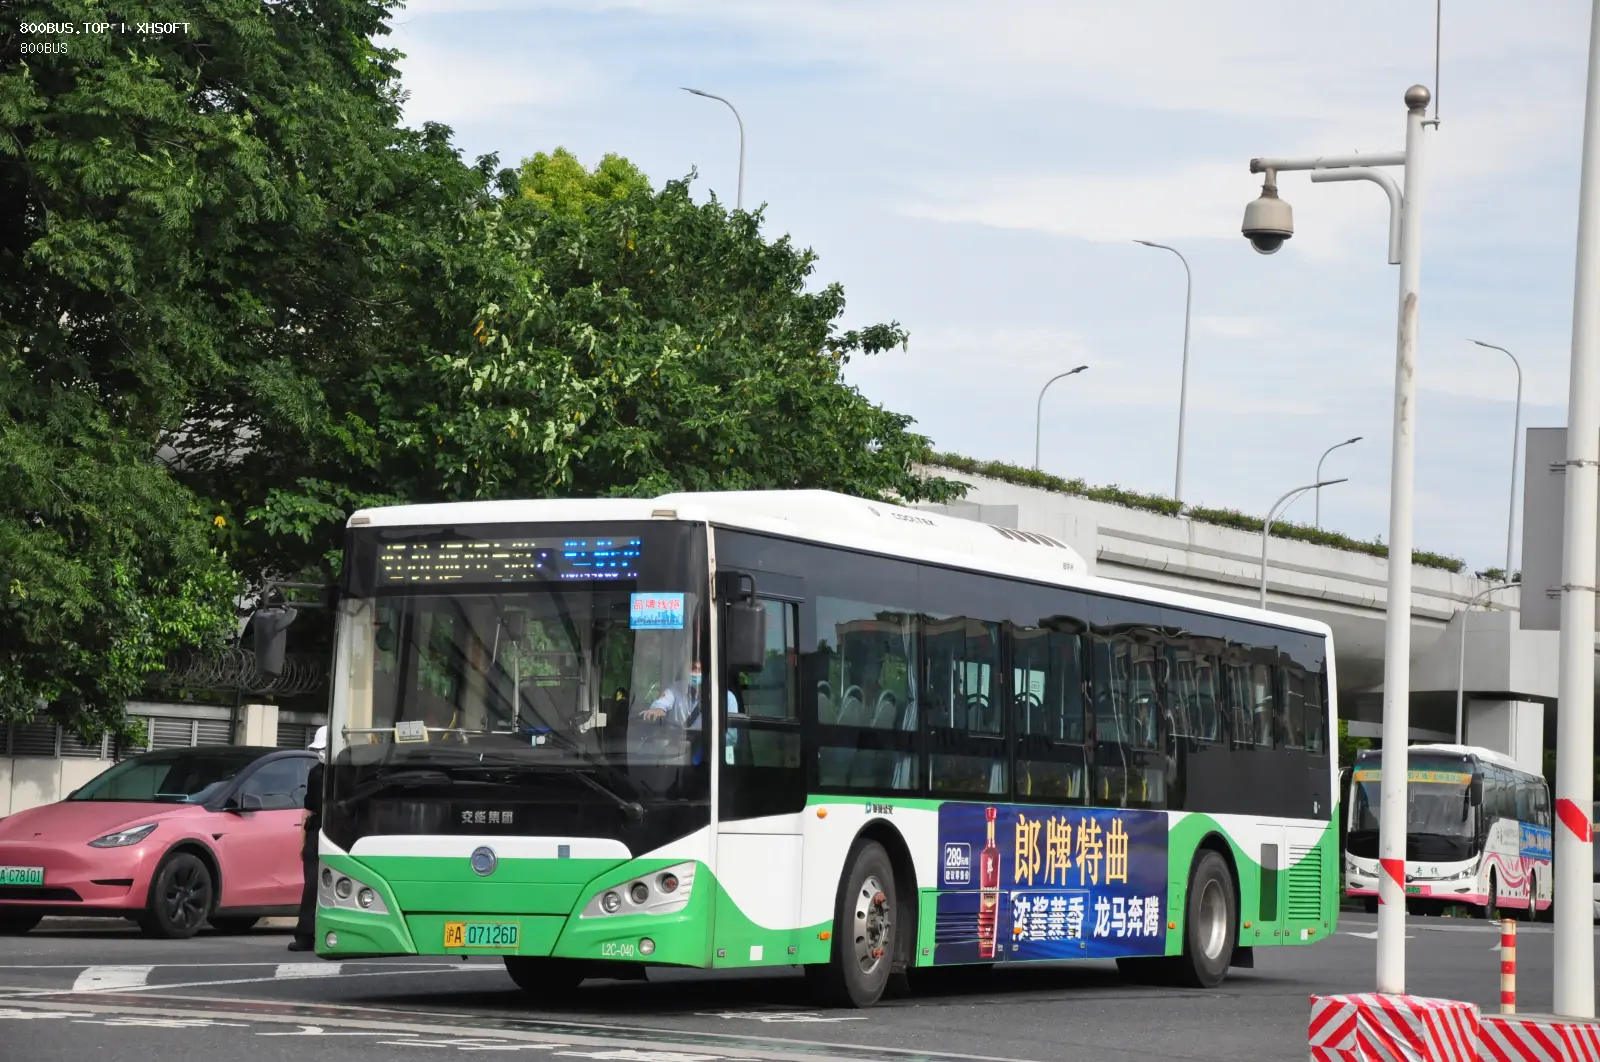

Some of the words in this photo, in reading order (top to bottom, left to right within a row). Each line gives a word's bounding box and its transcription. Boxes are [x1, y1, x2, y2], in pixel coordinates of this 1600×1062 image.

[634, 599, 681, 611] 品牌线路
[1014, 814, 1130, 887] 郎牌特曲
[1094, 895, 1159, 938] 龙马奔腾
[601, 942, 634, 957] L2C-040
